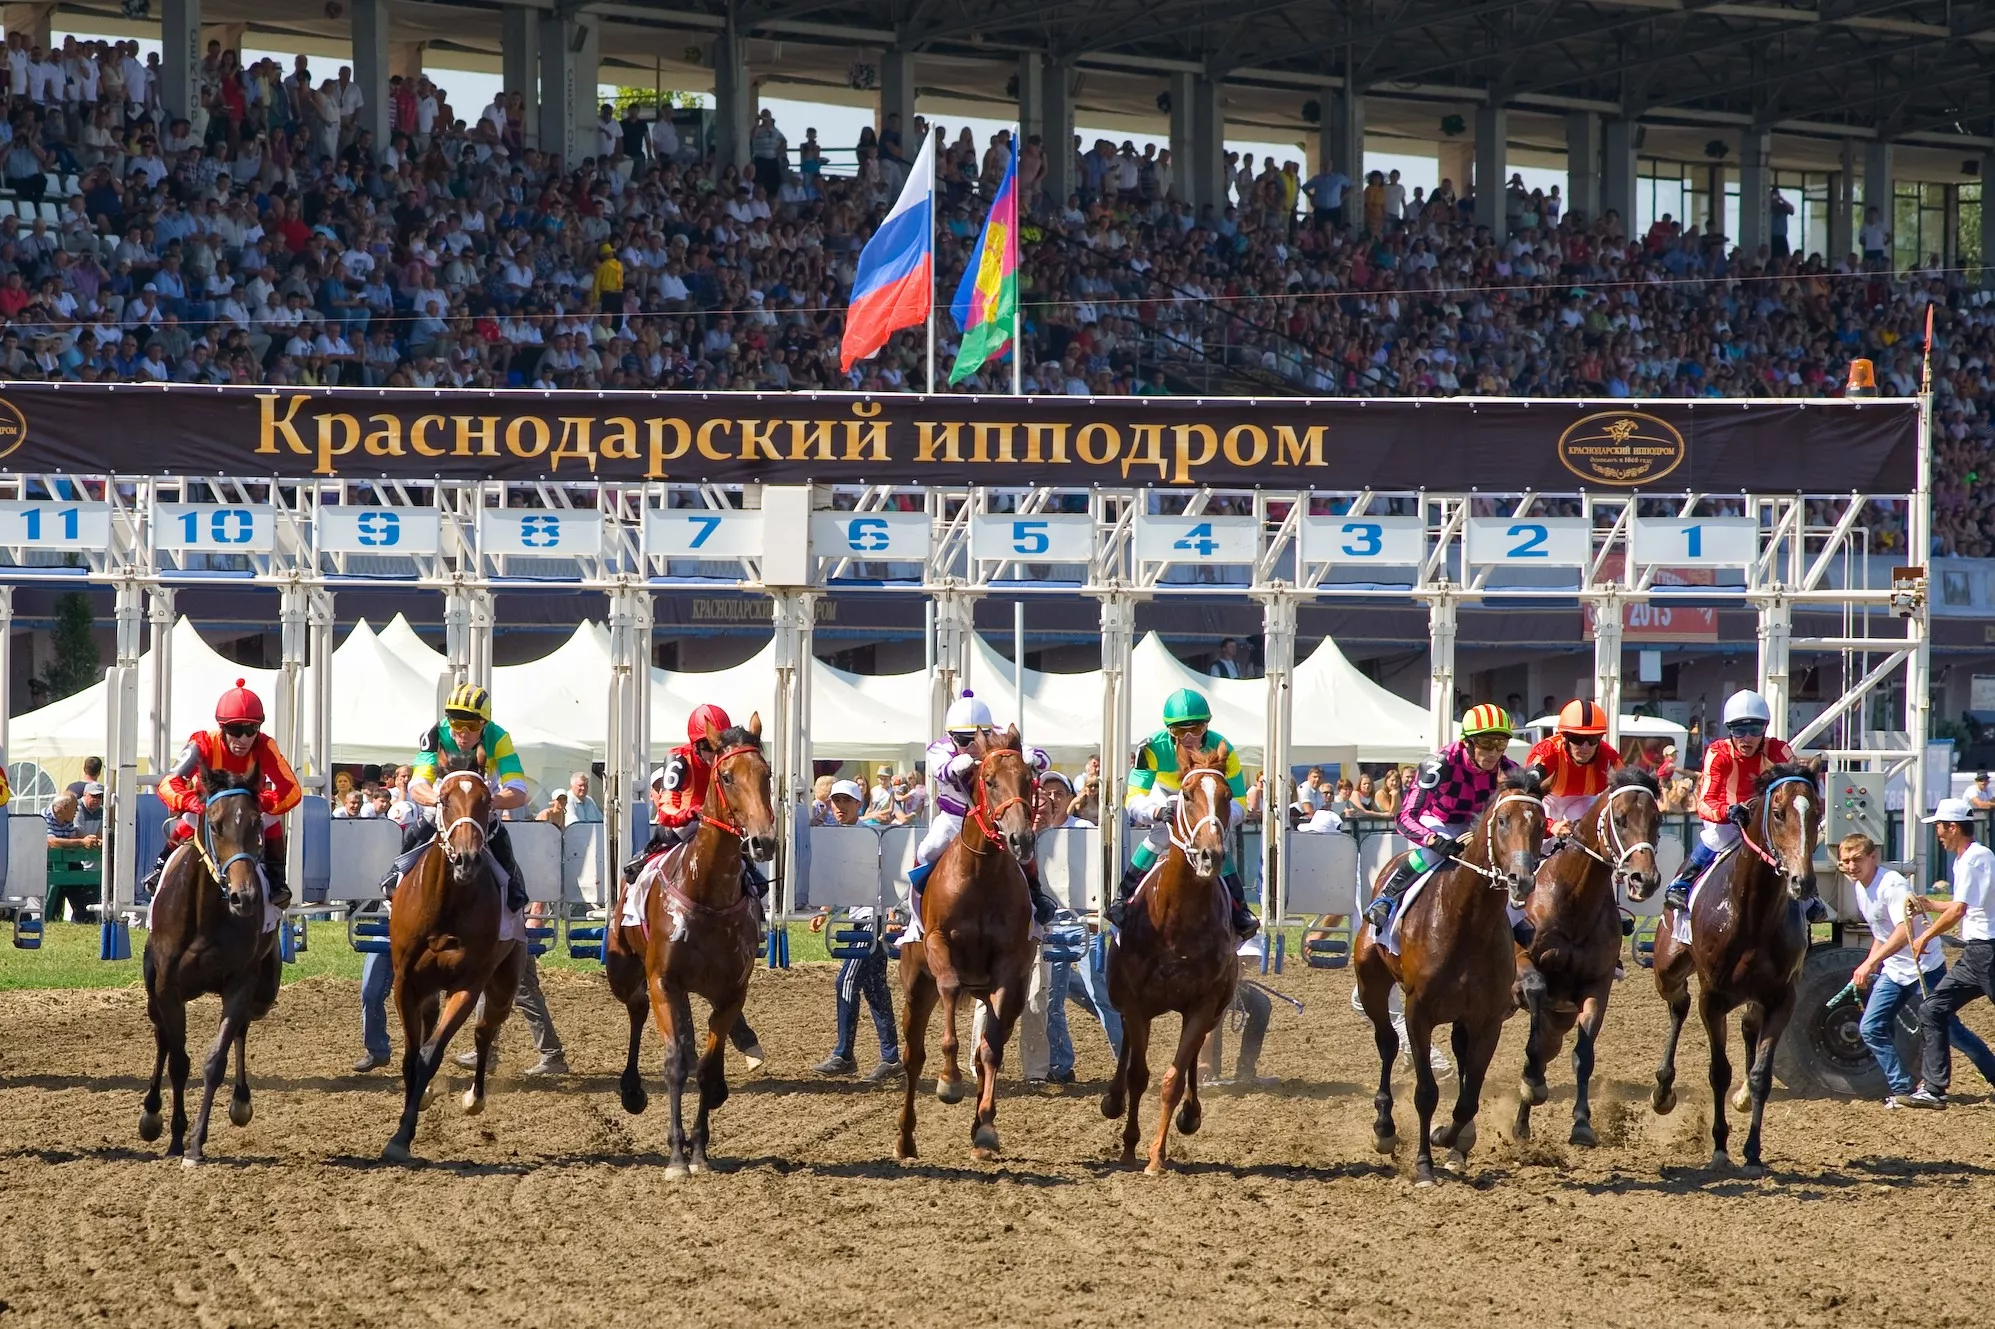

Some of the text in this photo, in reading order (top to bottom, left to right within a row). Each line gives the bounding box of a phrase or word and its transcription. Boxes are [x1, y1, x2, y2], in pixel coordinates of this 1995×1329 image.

[189, 29, 199, 124] СЕКТОР
[254, 393, 1328, 485] Краснодарский ипподром
[1568, 446, 1675, 456] КРАСНОДАРСКИЙ ИППОДРОМ
[20, 508, 79, 541] 11
[178, 509, 254, 544] 10
[357, 511, 401, 546] 9
[520, 515, 560, 548] 8
[687, 516, 722, 549] 7
[847, 518, 890, 551] 6
[1012, 521, 1049, 554] 5
[1173, 523, 1219, 556] 4
[1341, 523, 1383, 557] 3
[1506, 525, 1549, 558] 2
[1681, 525, 1702, 558] 1
[663, 760, 683, 790] 6
[1418, 760, 1443, 789] 3
